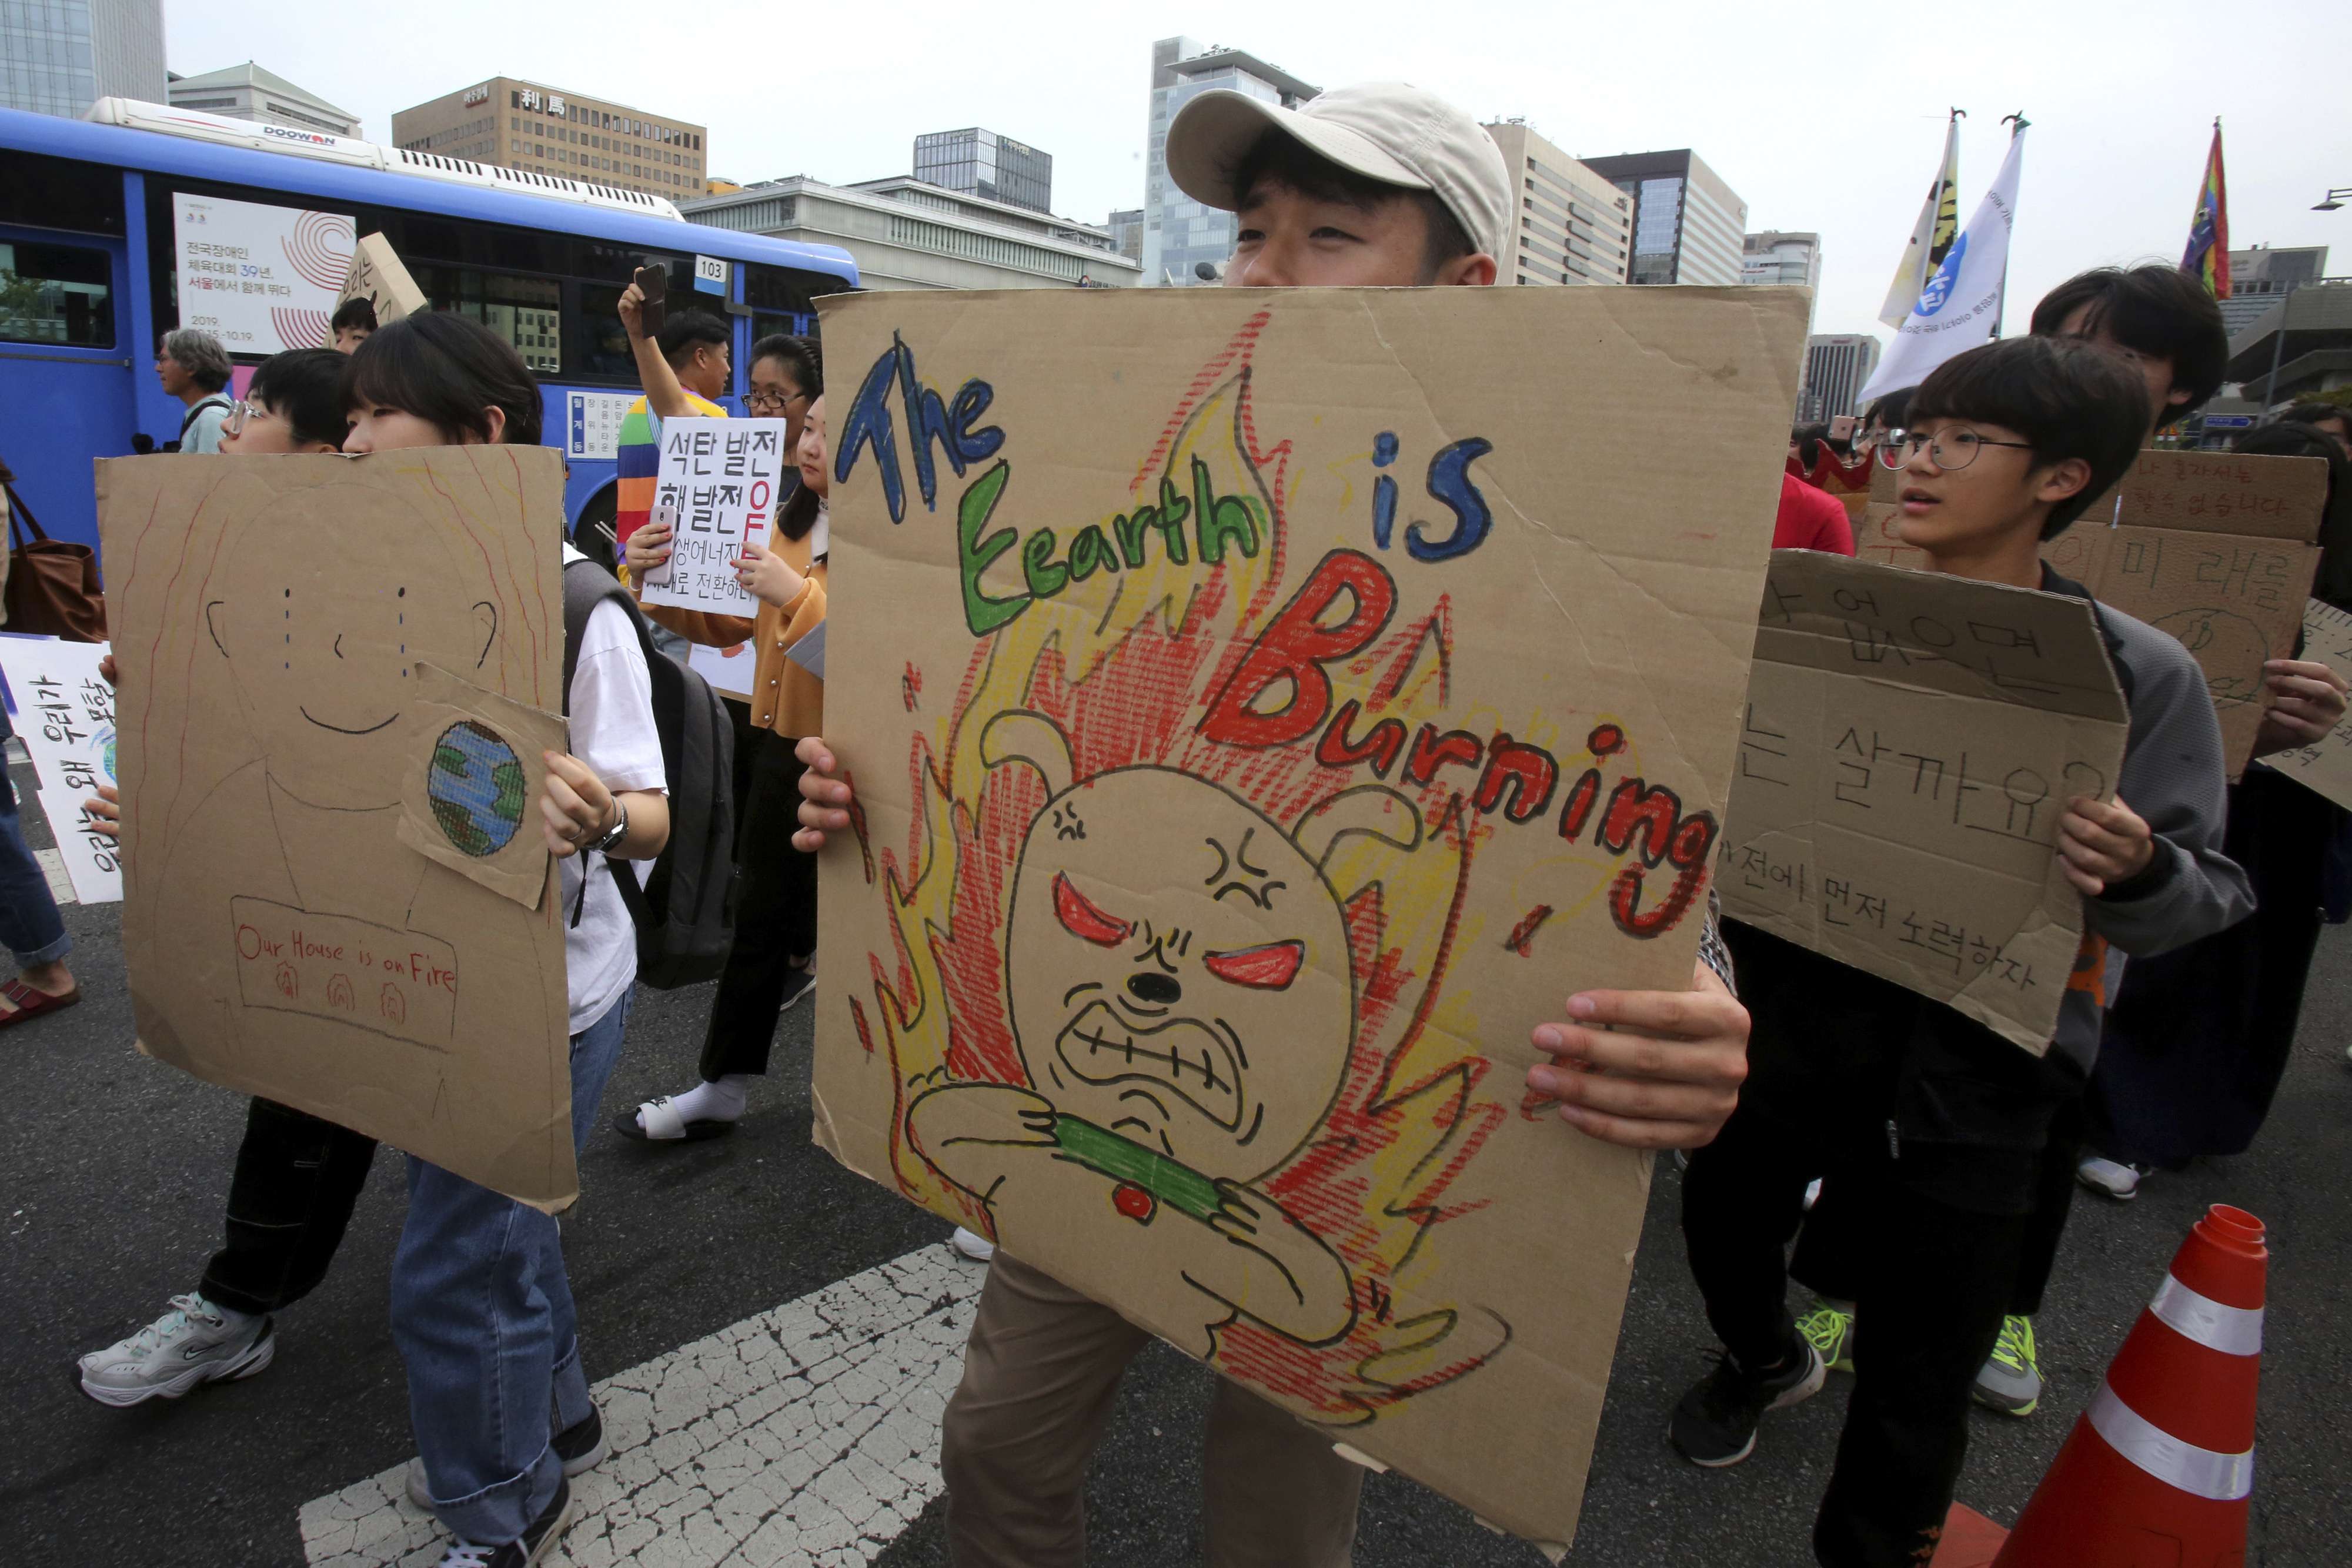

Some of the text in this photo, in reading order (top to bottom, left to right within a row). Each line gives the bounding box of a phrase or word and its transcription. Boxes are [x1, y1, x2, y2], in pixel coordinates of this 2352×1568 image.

[263, 126, 335, 145] DOOWON
[186, 242, 249, 260] 전국장애인
[188, 259, 237, 276] 체육대회
[701, 260, 721, 278] 103
[188, 276, 292, 297] 서울에서 함께 뛰다
[192, 316, 220, 327] 2019.
[668, 431, 777, 477] 석탄 발전
[834, 329, 1006, 525] The
[1372, 430, 1494, 564] is
[691, 484, 743, 534] 발전
[2187, 493, 2291, 517] 없습니다
[675, 538, 739, 569] 생에너지
[28, 674, 88, 745] 우리가
[1194, 547, 1719, 939] Burning
[1741, 845, 2036, 991] 전에 먼저 노력하자
[237, 924, 456, 994] Our House is on Fire
